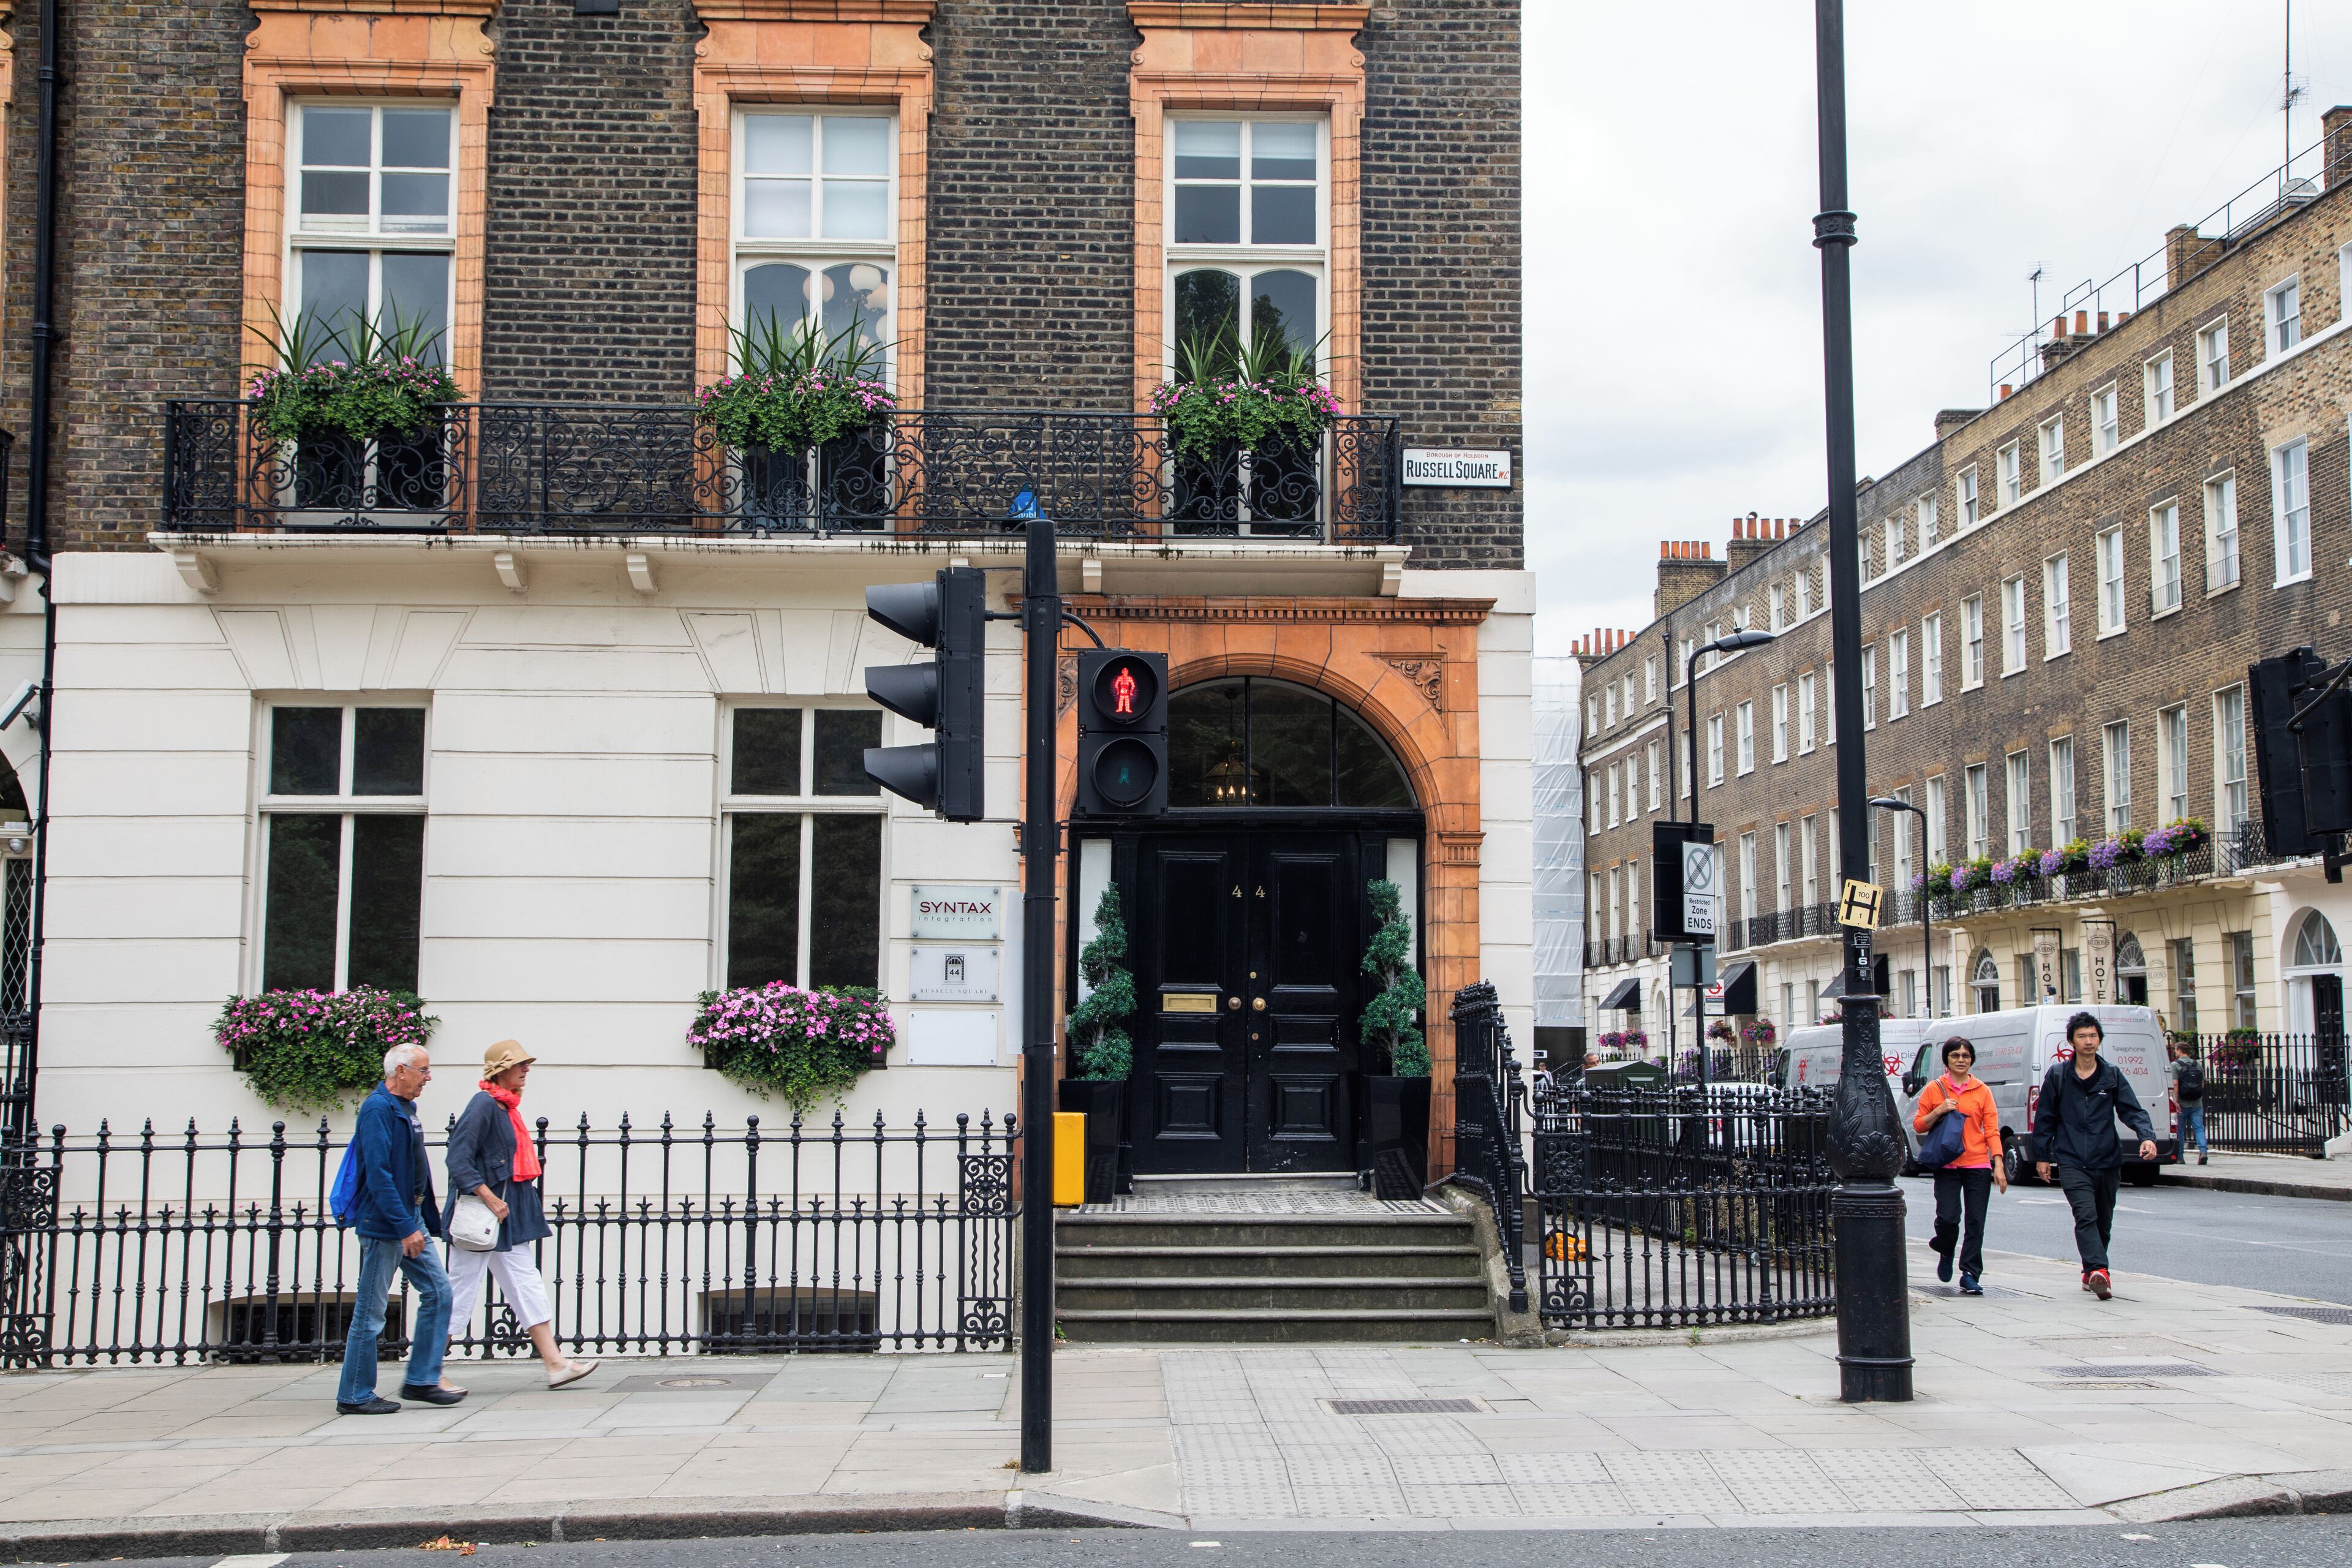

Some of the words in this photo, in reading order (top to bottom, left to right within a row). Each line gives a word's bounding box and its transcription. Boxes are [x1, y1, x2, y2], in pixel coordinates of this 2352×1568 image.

[1406, 459, 1454, 478] RUSSELL
[1456, 461, 1498, 480] SQUARE
[1232, 884, 1242, 897] 4
[1255, 885, 1265, 898] 4
[919, 902, 992, 914] SYNTAX
[1692, 905, 1708, 915] Zone
[1688, 917, 1712, 930] ENDS
[2042, 963, 2052, 993] HOT
[2095, 957, 2106, 1005] HOTE
[1901, 1050, 1916, 1060] pie
[2117, 1056, 2143, 1065] 01992
[2121, 1067, 2130, 1076] 76
